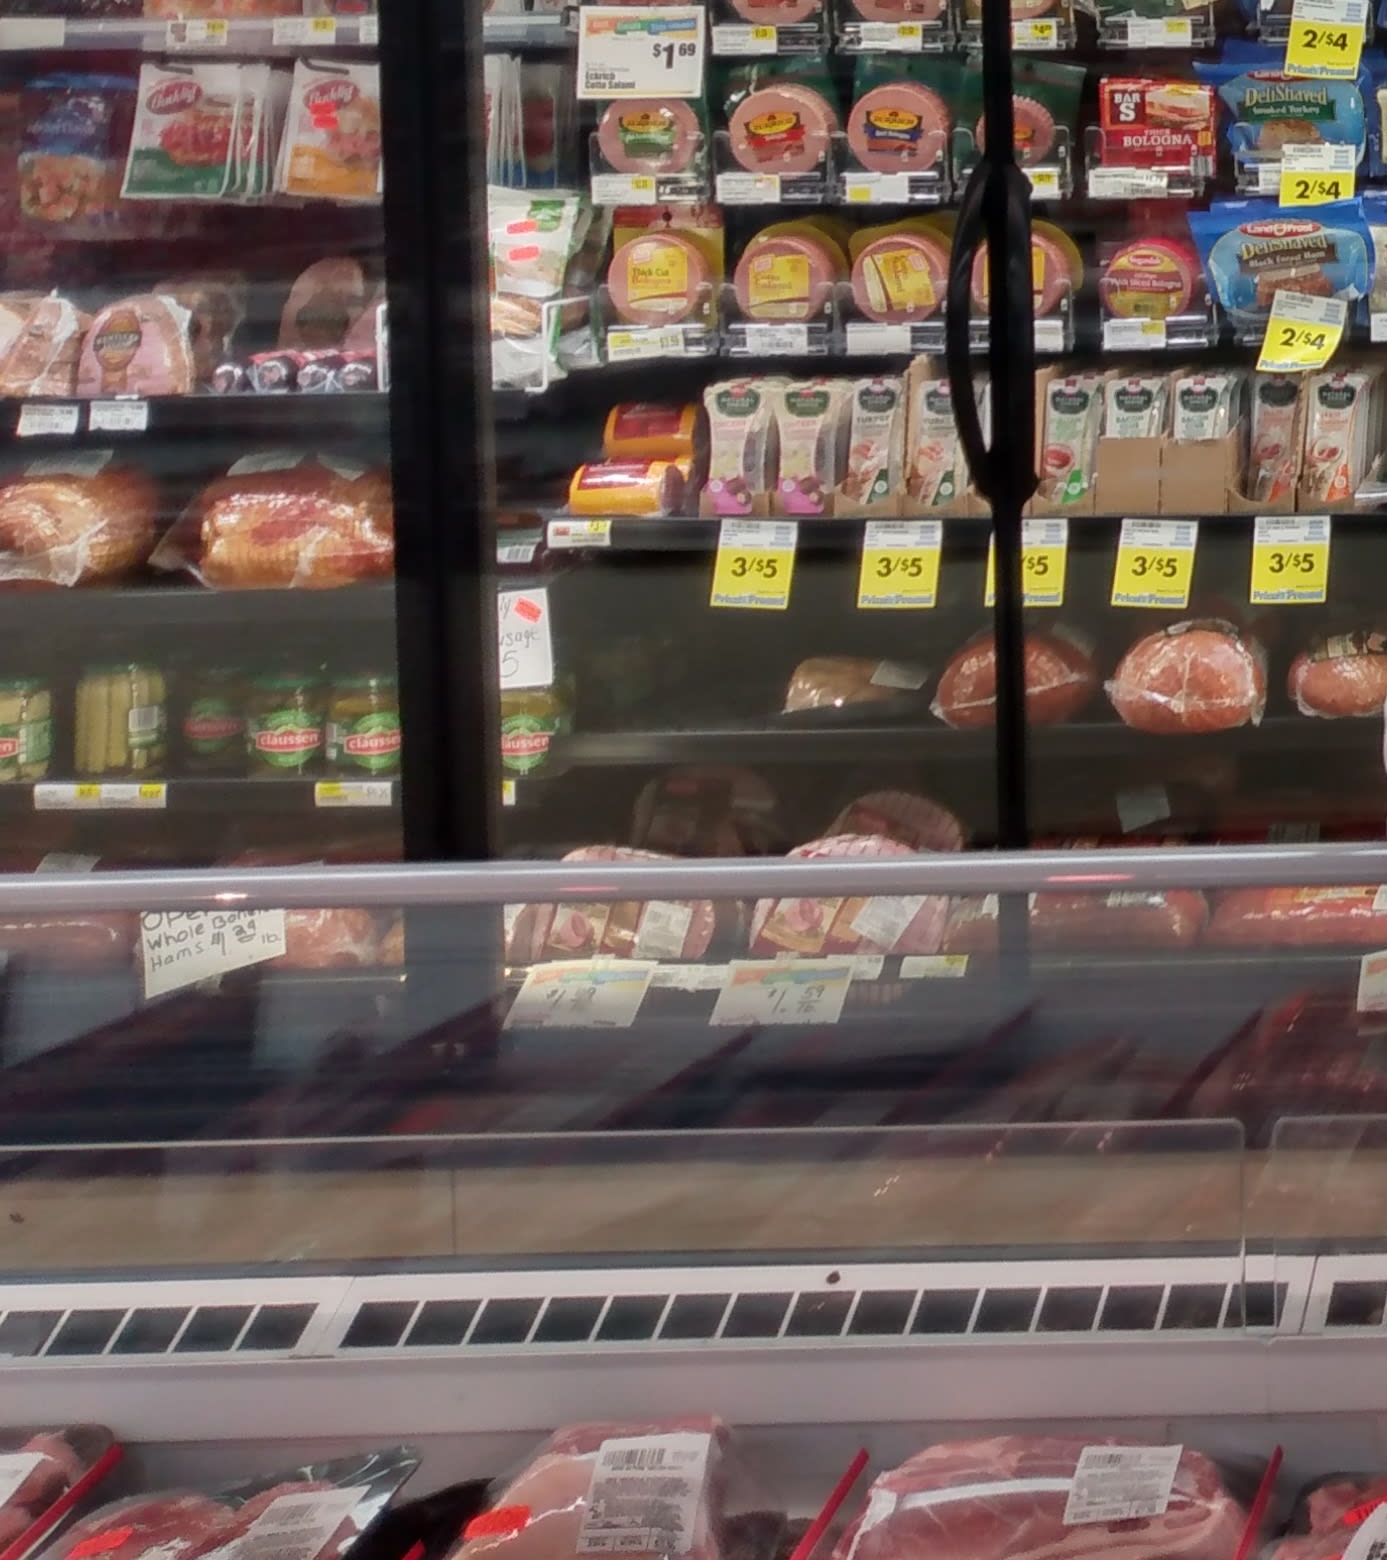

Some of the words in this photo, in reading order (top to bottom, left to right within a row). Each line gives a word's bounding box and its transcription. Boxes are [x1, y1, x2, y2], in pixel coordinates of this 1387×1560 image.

[1302, 30, 1348, 51] 2/$4
[1114, 93, 1141, 104] BAR
[1119, 103, 1136, 122] S
[1123, 134, 1192, 147] BOLOGNA
[1295, 180, 1341, 200] 2/$4
[1280, 327, 1326, 351] 2/$4
[731, 556, 778, 579] 3/$5
[876, 556, 923, 578] 3/$5
[1131, 555, 1177, 578] 3/$5
[1268, 552, 1315, 573] 3/$5
[259, 733, 318, 748] claussen
[147, 923, 205, 951] Whole
